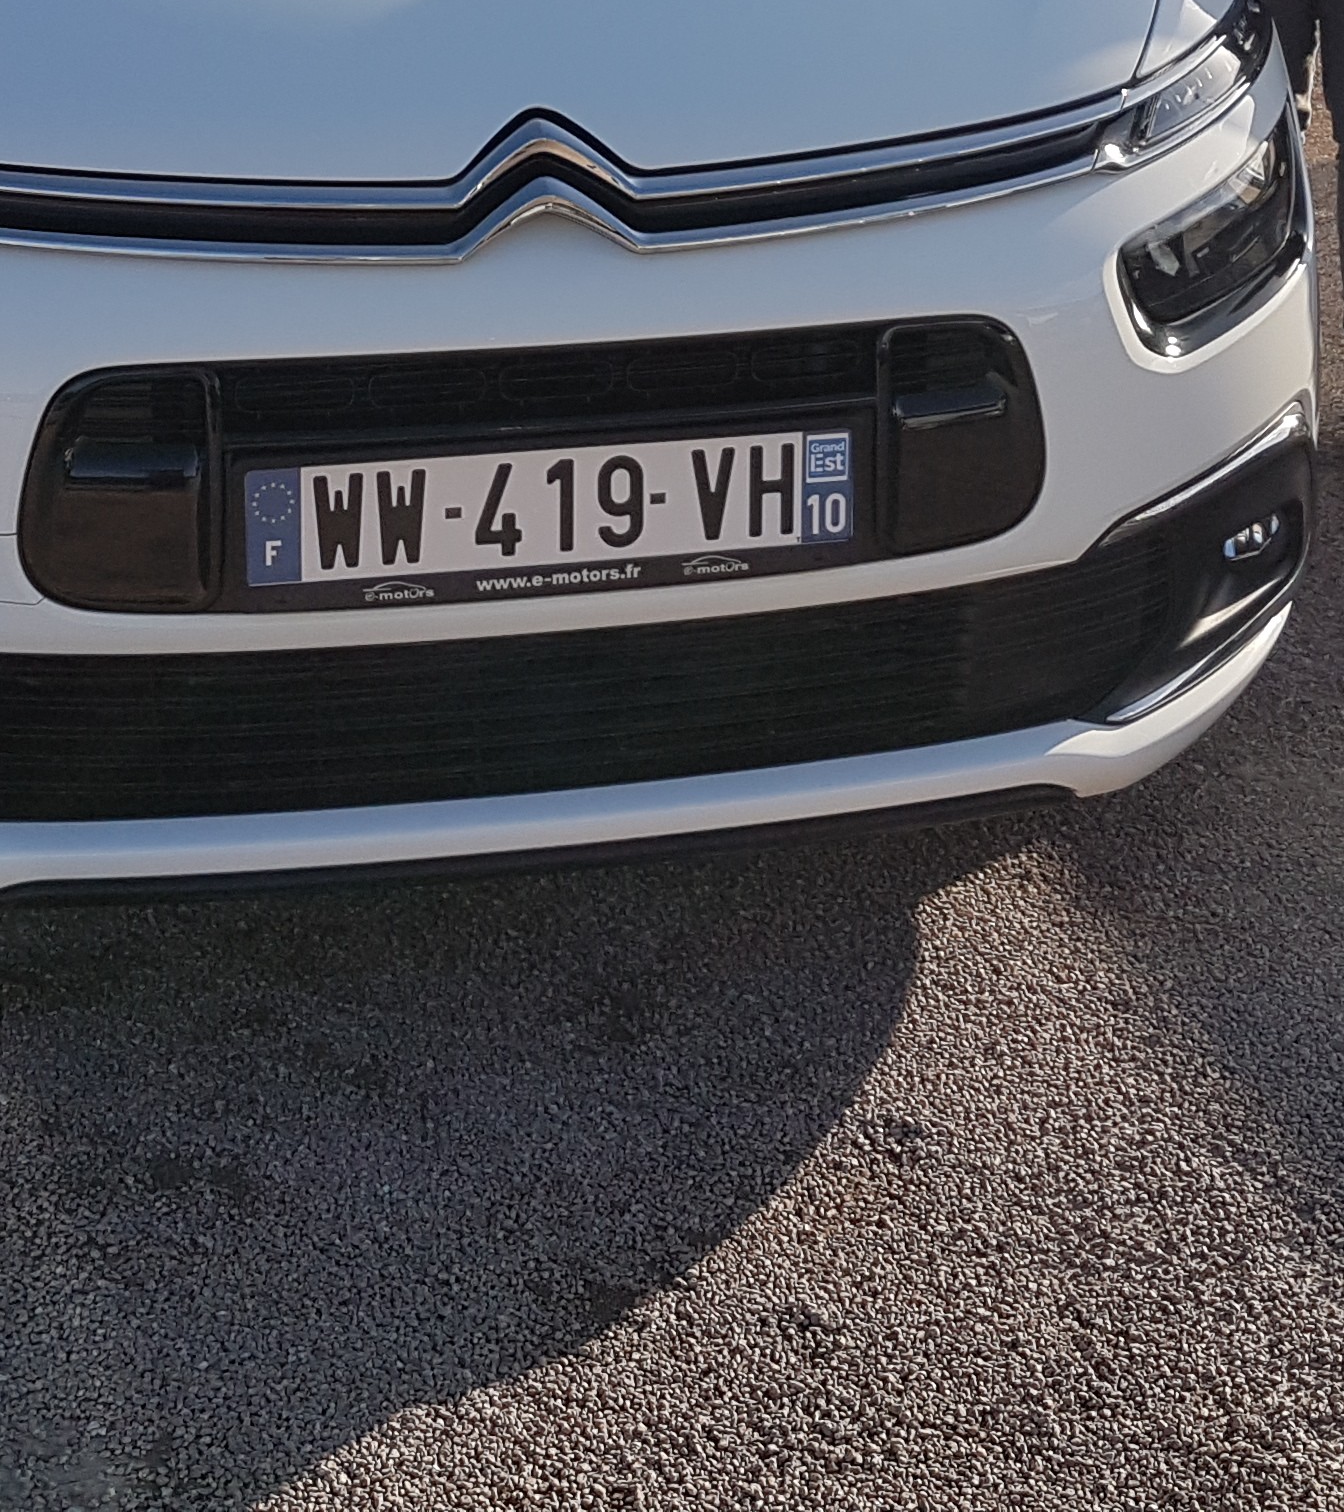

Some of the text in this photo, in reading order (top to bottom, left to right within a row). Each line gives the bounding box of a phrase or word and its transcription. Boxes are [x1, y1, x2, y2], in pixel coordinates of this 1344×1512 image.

[810, 441, 846, 454] Grand
[810, 452, 845, 473] Est
[806, 492, 847, 536] 10
[265, 539, 283, 567] F
[476, 562, 642, 592] www.e-motors.fr
